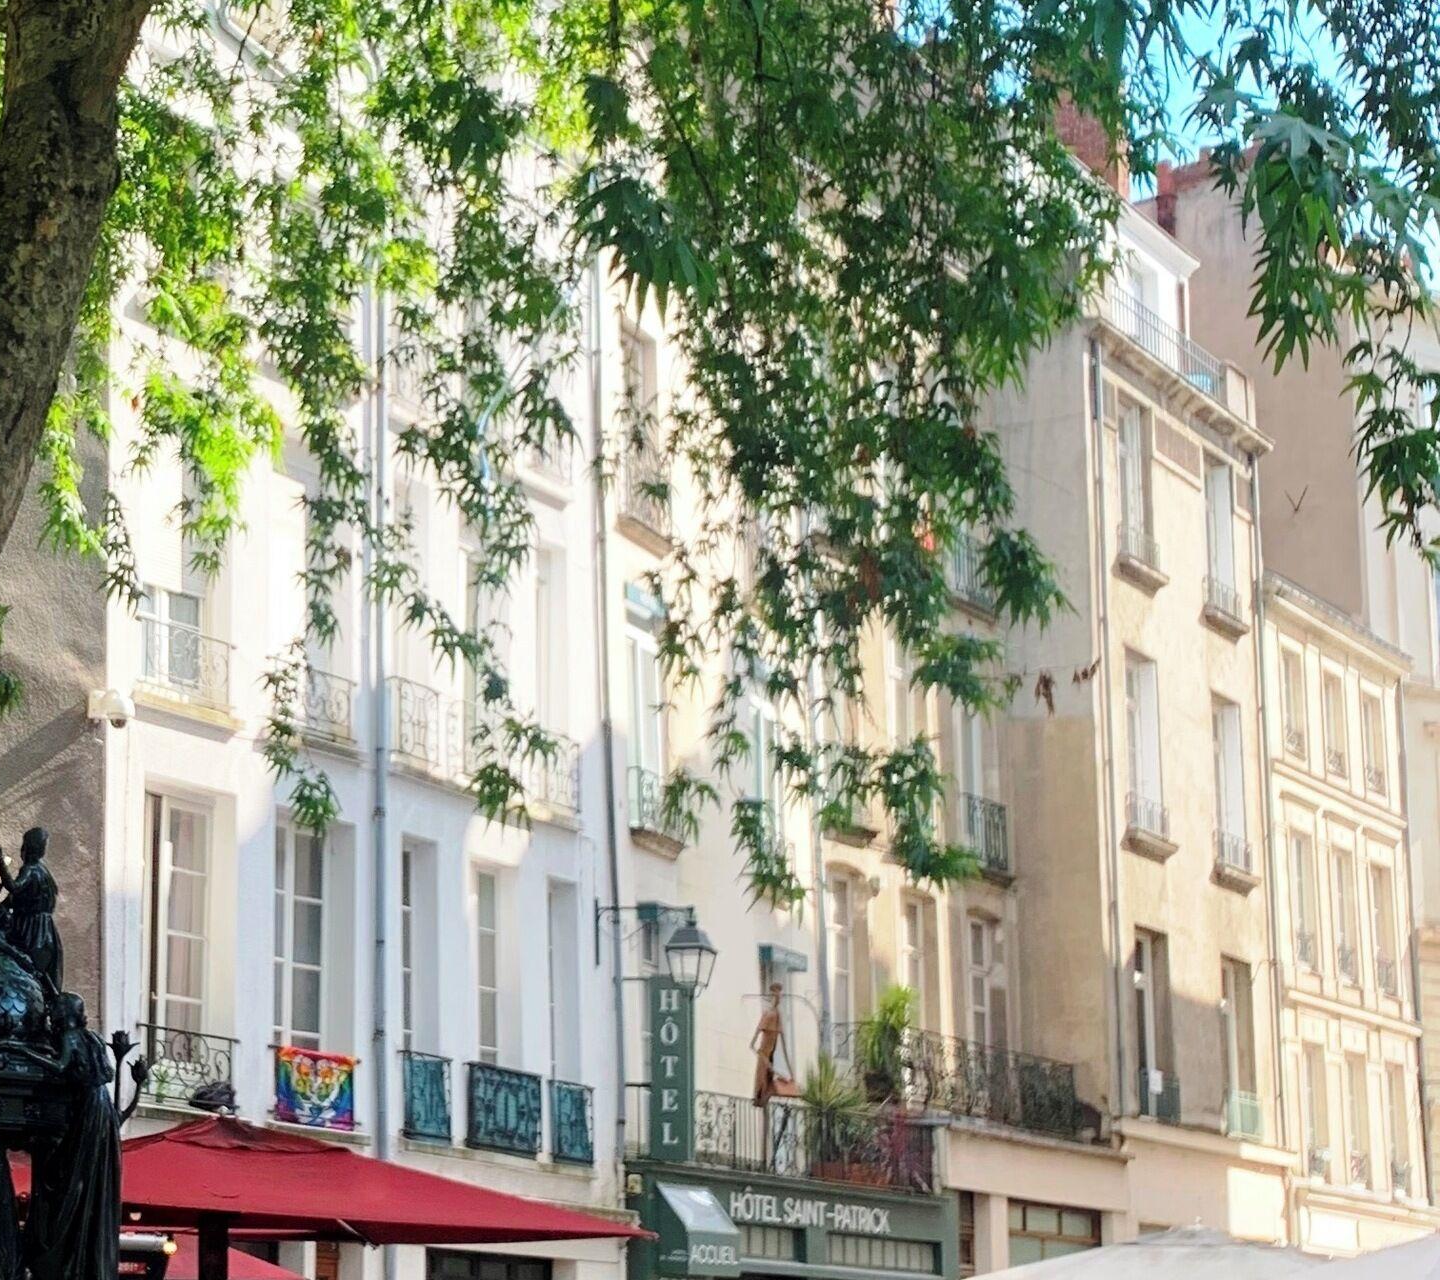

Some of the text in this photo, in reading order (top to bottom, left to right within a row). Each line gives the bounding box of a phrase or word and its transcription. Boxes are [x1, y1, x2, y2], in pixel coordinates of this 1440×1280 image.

[659, 988, 681, 1145] HÔTEL
[729, 1185, 891, 1234] HÔTEL SAINT-PATRICK
[689, 1244, 738, 1265] ACCUEIL
